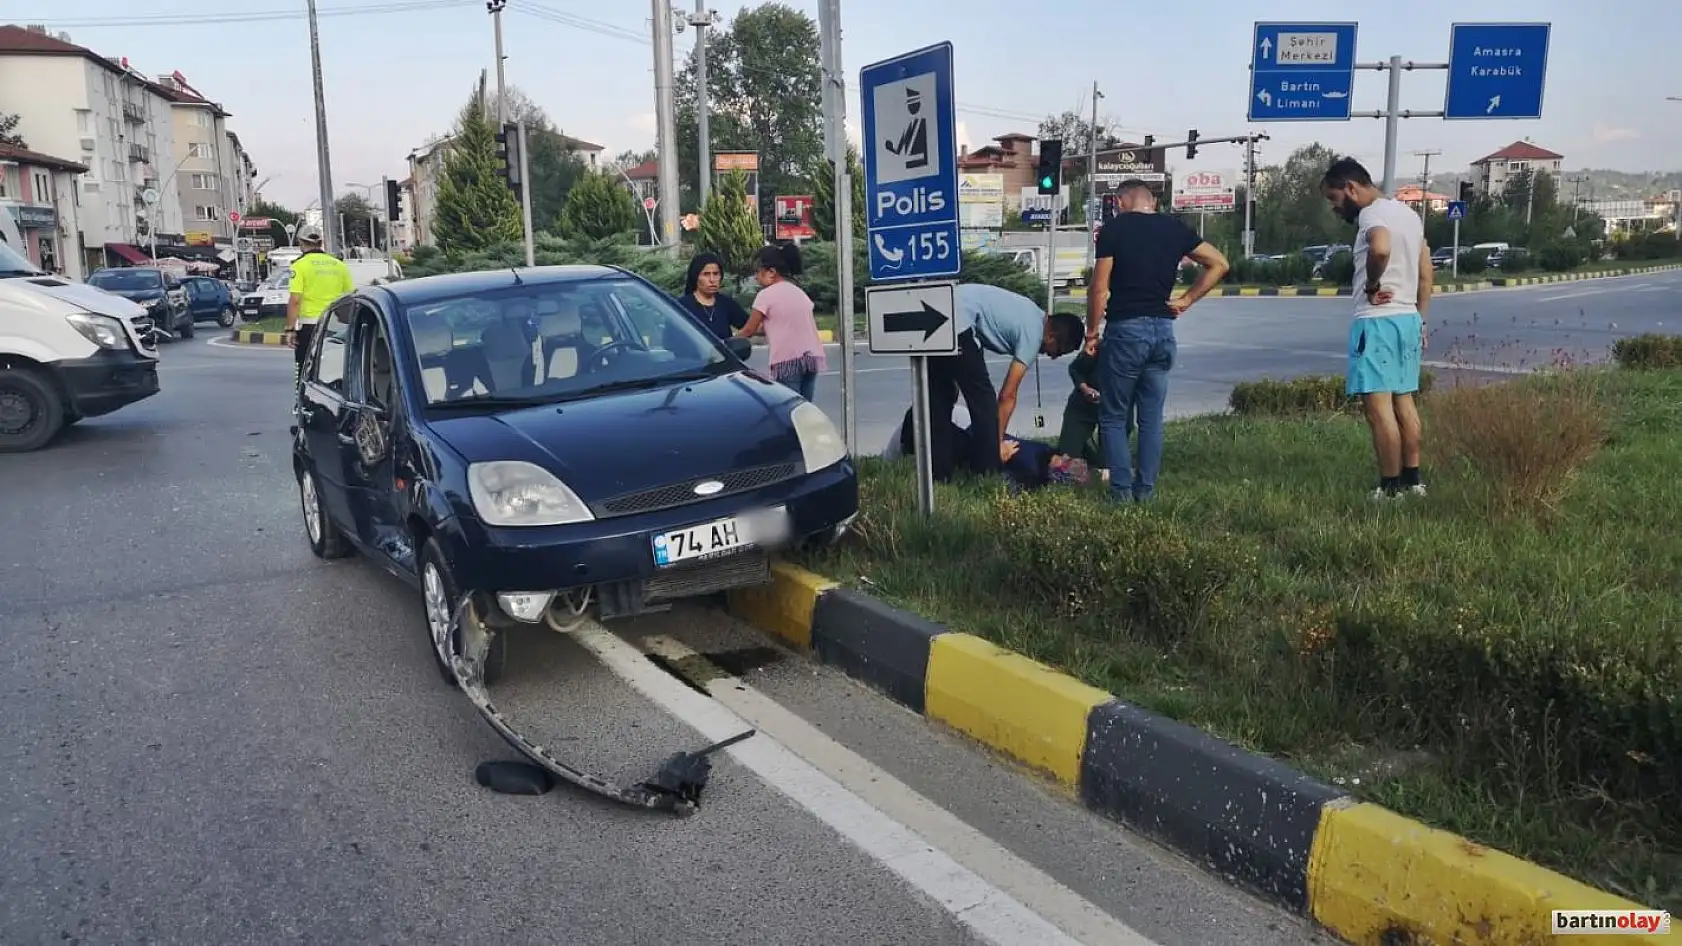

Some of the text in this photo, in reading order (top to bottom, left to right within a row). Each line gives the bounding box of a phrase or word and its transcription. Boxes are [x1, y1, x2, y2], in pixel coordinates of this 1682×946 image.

[1289, 36, 1326, 47] Şehir
[1280, 50, 1333, 60] Merkezi
[1473, 46, 1522, 57] Amasra
[1470, 65, 1522, 76] Karabük
[1281, 80, 1320, 92] Bartın
[1277, 98, 1320, 109] Limanı
[877, 186, 946, 218] Polis
[907, 231, 950, 261] 155
[671, 531, 703, 558] 74
[711, 520, 739, 549] AH
